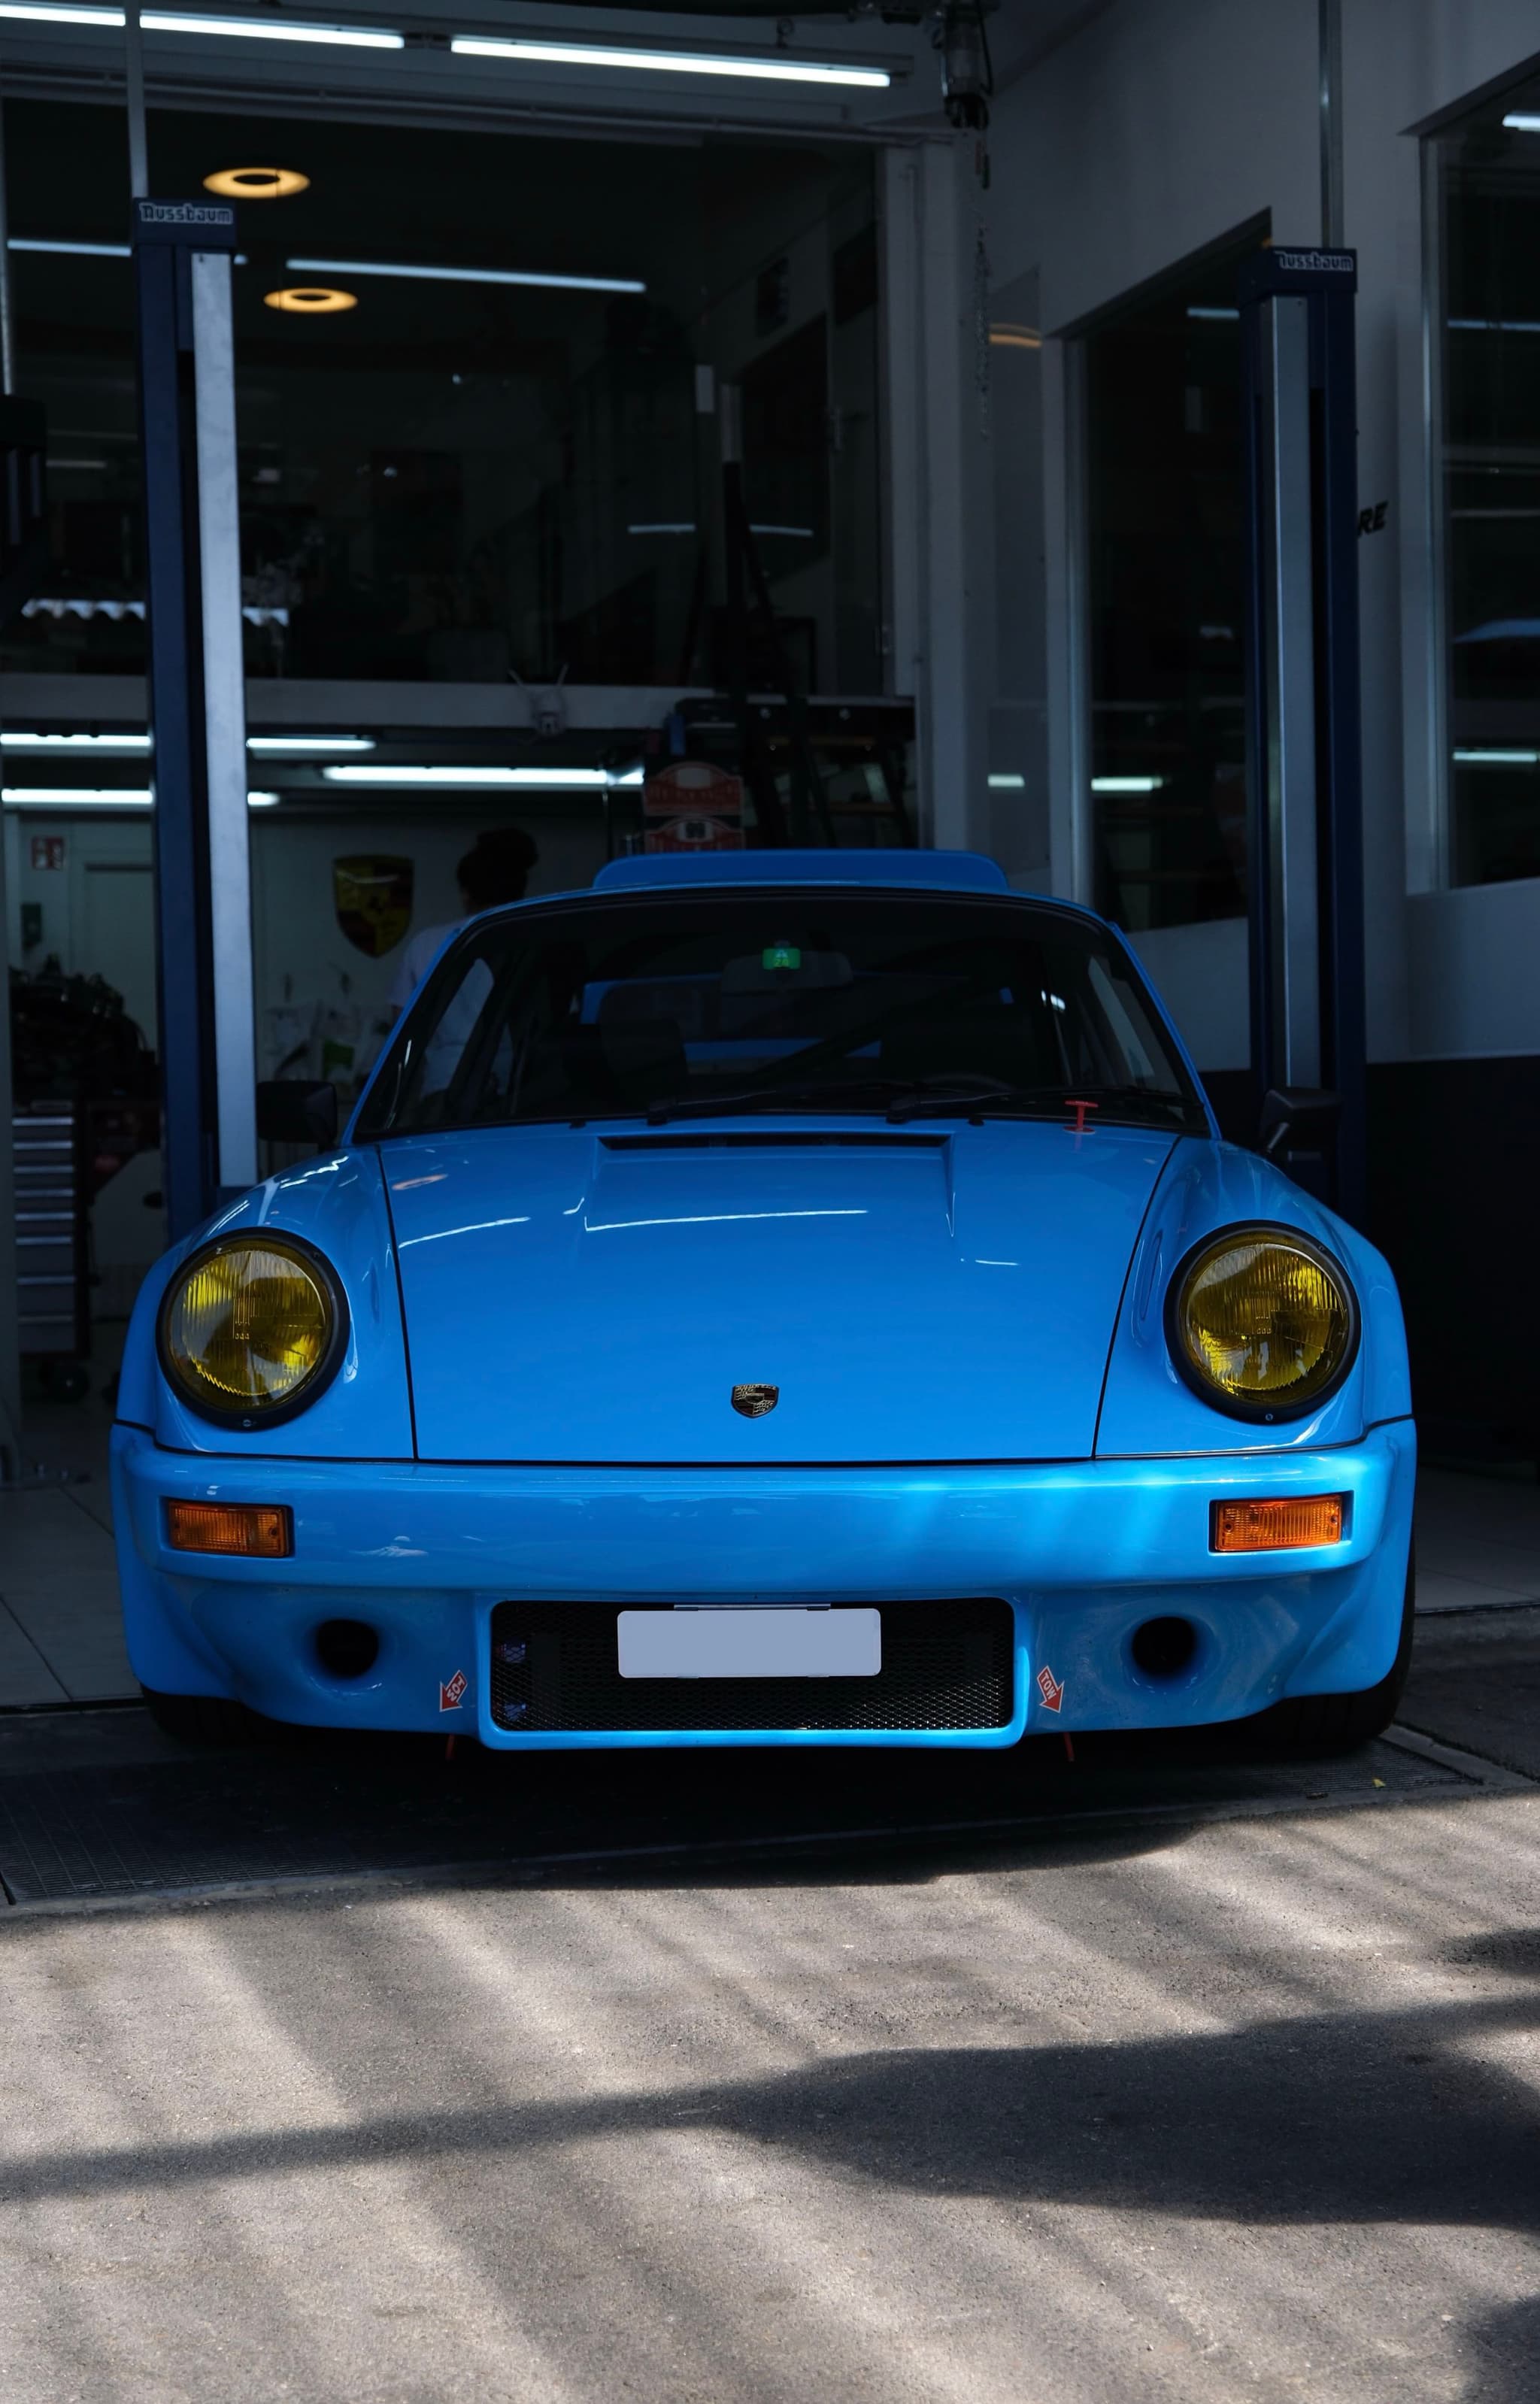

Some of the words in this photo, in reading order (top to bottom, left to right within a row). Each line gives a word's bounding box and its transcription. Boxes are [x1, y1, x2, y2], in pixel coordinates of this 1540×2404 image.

[141, 204, 232, 223] Nussbaum
[447, 1675, 465, 1702] TOW
[1041, 1672, 1056, 1700] TOW
